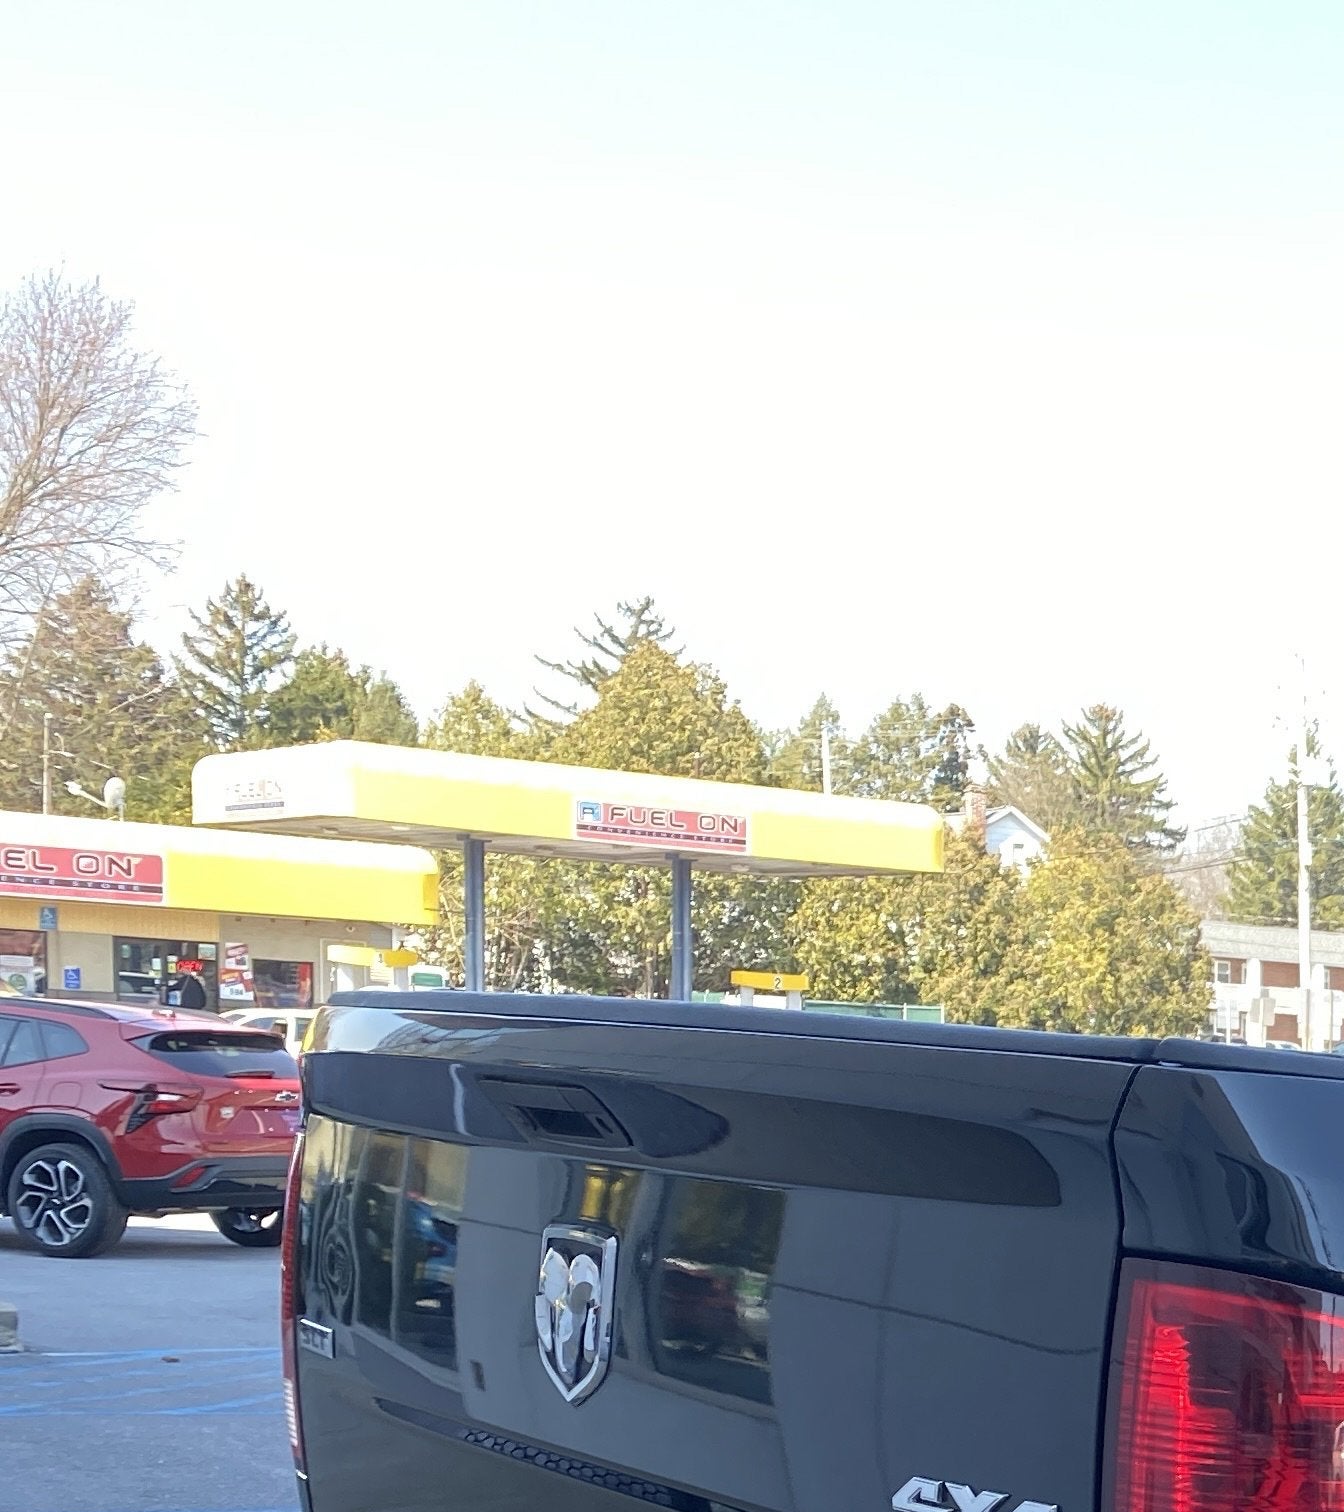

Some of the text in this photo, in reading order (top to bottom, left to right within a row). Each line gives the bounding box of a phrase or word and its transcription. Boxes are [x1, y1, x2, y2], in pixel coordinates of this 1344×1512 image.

[609, 805, 686, 830] FUEL
[698, 814, 740, 834] ON
[74, 853, 135, 877] ON
[72, 880, 141, 891] STORE
[774, 977, 781, 989] 2
